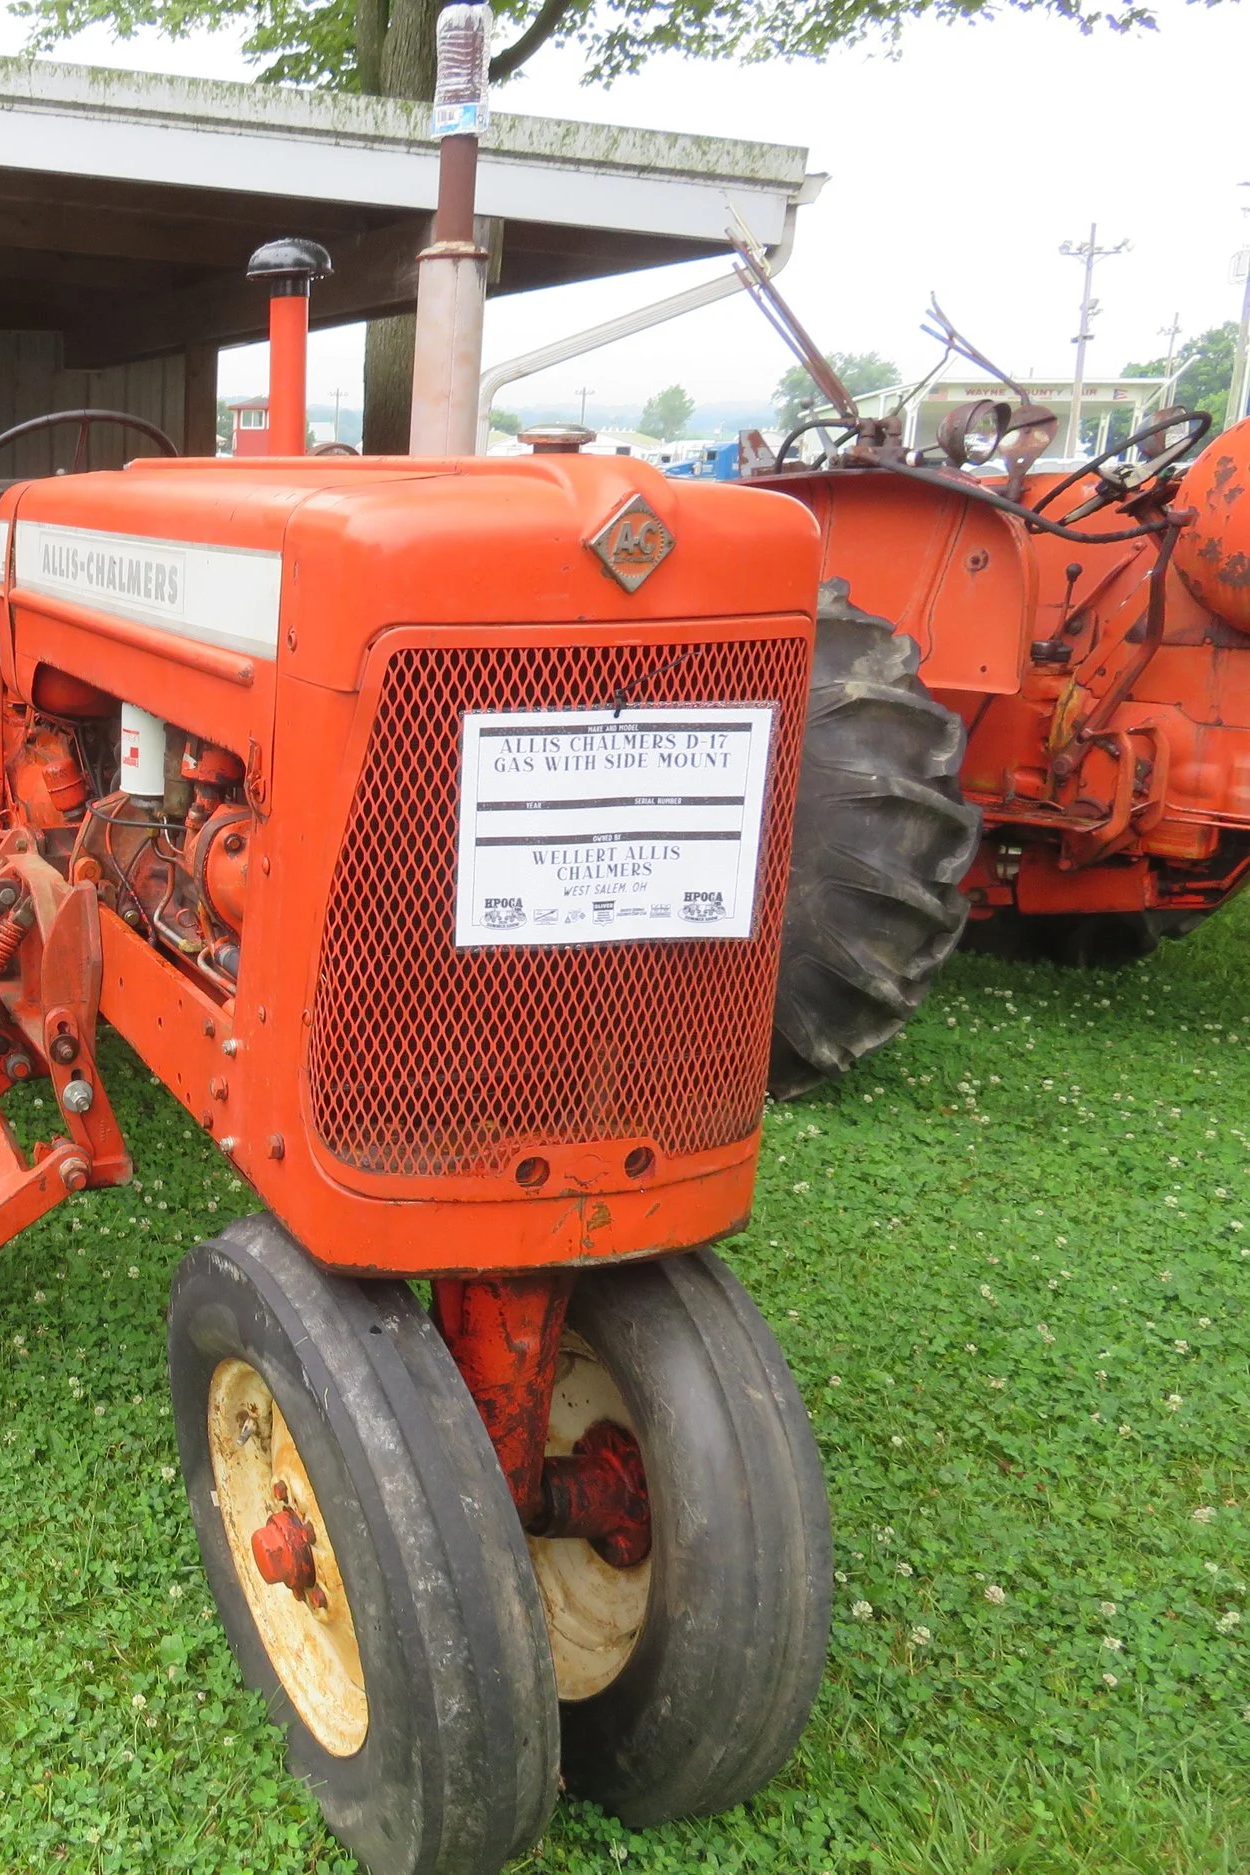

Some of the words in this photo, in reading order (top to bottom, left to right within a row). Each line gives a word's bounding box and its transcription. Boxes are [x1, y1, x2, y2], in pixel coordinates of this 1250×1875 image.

[965, 388, 1006, 396] WAYNE
[1014, 388, 1064, 396] OUNTY
[41, 543, 178, 604] ALLIS-CHALMERS
[587, 725, 603, 733] MAKE
[619, 724, 639, 732] MODEL
[500, 736, 561, 753] ALLIS
[570, 733, 676, 752] CHALMERS
[686, 734, 729, 749] D-17
[494, 756, 534, 773] GAS
[545, 754, 596, 771] WITH
[604, 753, 648, 769] SIDE
[657, 752, 731, 768] MOUNT
[634, 797, 655, 805] SERIAL
[592, 834, 612, 842] OWNED
[613, 833, 622, 841] BY
[532, 847, 617, 865] WELLERT
[624, 845, 681, 861] ALLIS
[556, 862, 652, 881] CHALMERS
[564, 884, 591, 896] WEST
[632, 881, 647, 893] OH
[485, 898, 523, 908] HPOCA
[683, 892, 723, 902] HPOCA
